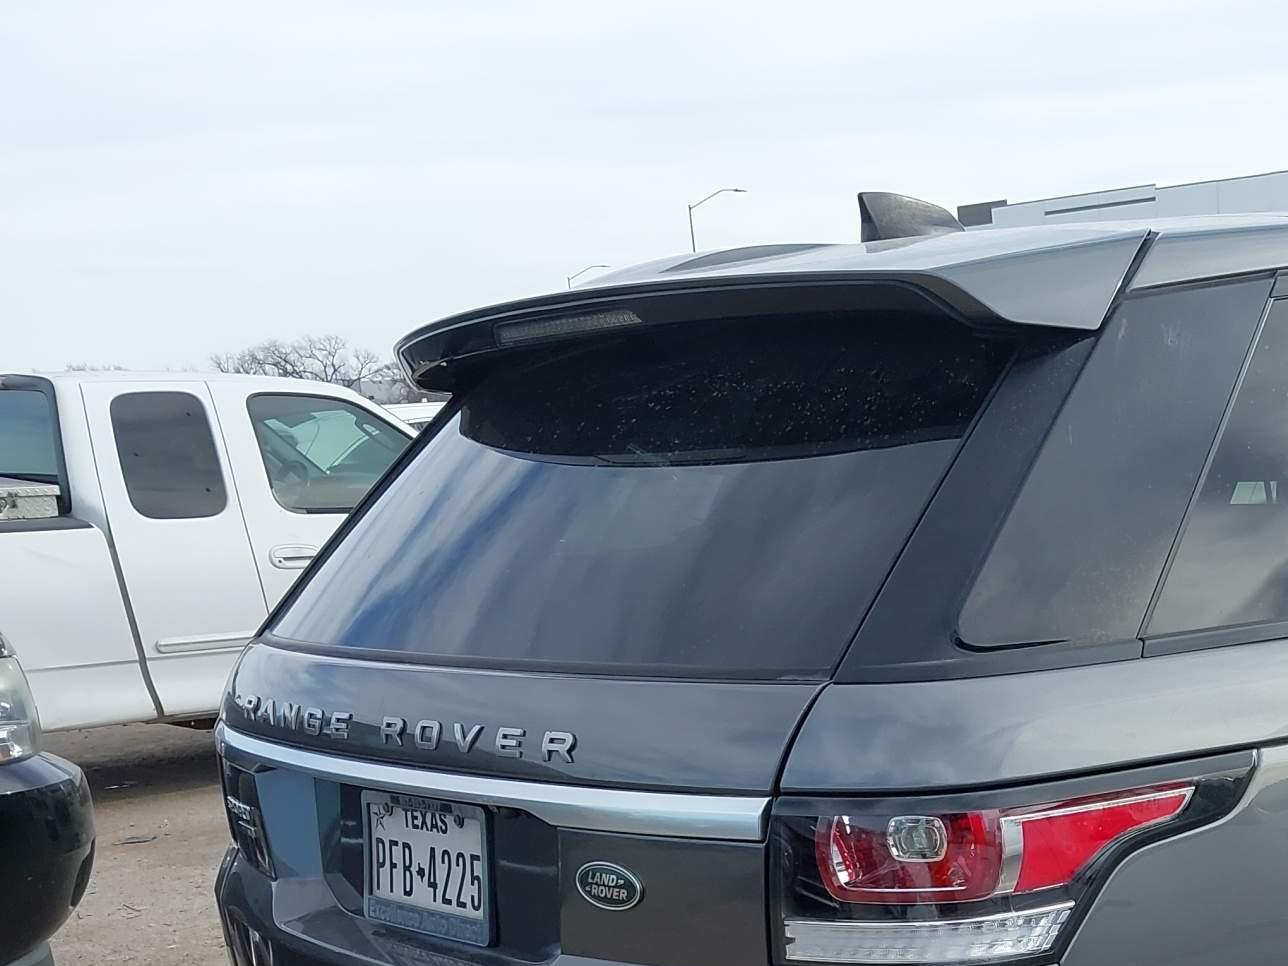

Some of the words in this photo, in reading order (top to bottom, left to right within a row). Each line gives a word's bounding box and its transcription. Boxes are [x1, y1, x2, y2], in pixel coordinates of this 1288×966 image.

[243, 694, 353, 741] RANGE
[380, 715, 576, 764] ROVER
[402, 808, 448, 834] TEXAS
[375, 837, 414, 897] PFB
[427, 846, 482, 911] 4225
[588, 871, 617, 886] LAND
[591, 884, 628, 900] ROVER
